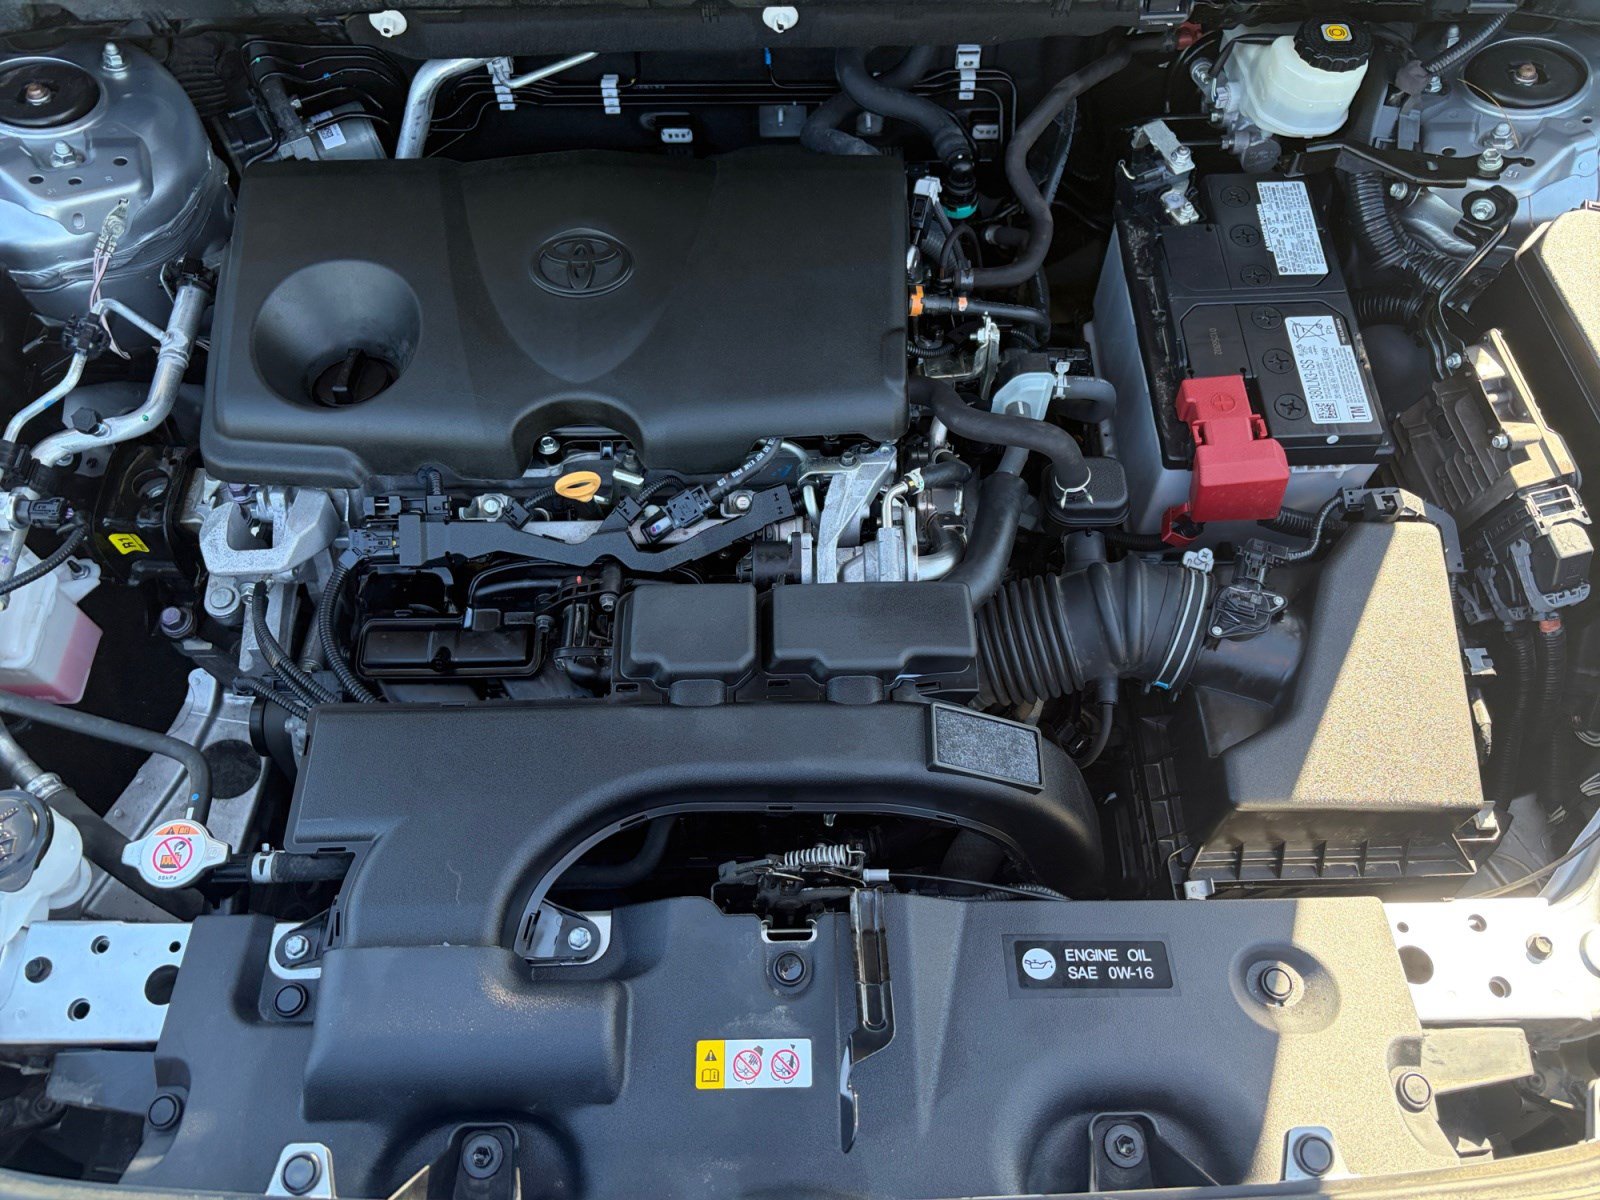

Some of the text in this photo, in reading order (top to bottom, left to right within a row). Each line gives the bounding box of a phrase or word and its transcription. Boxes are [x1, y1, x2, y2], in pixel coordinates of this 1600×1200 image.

[1326, 325, 1334, 334] Pb
[1350, 406, 1366, 418] TM
[1065, 949, 1152, 962] ENGINE OIL
[1068, 966, 1154, 980] SAE 0W-16
